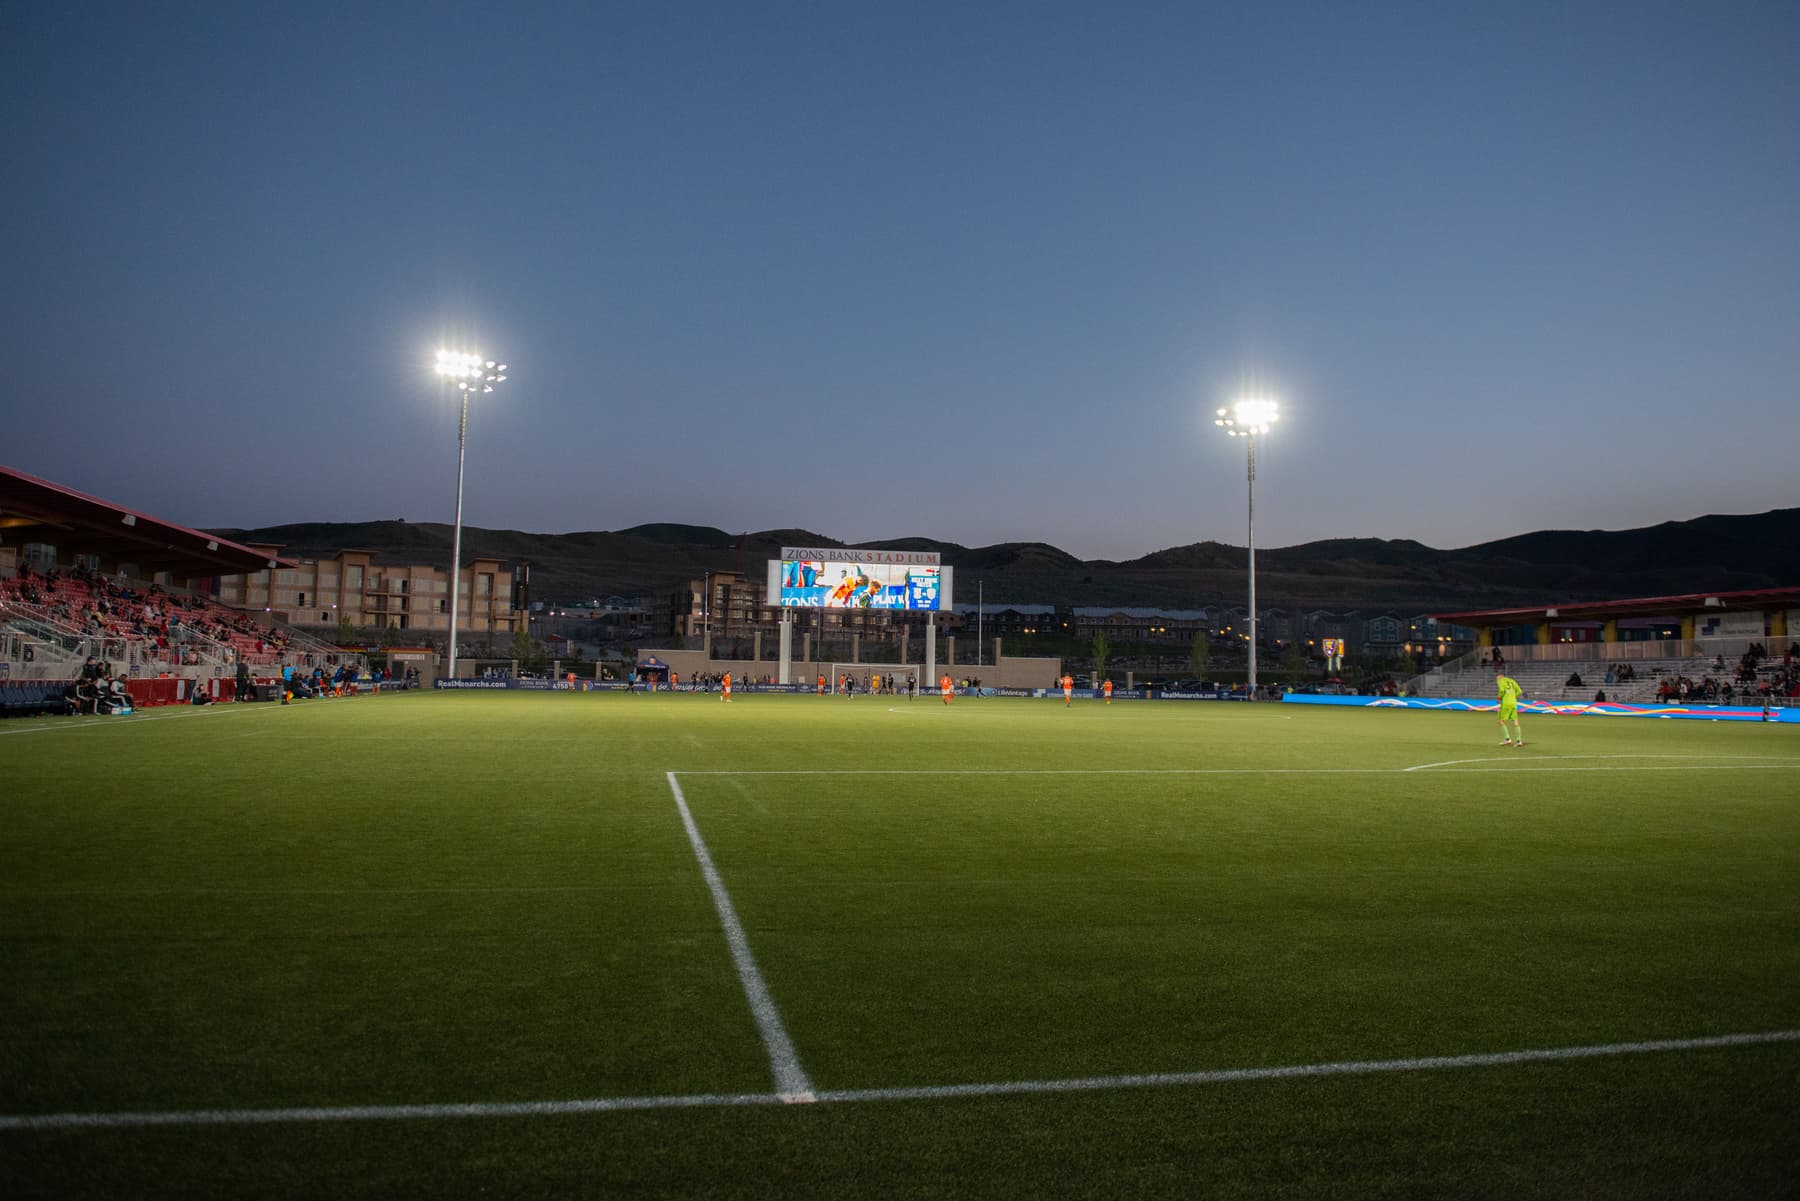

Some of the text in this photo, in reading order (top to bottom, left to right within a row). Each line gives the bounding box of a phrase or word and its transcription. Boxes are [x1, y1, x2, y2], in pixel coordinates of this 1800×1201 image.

[787, 549, 937, 563] ZIONS BANK STADIUM
